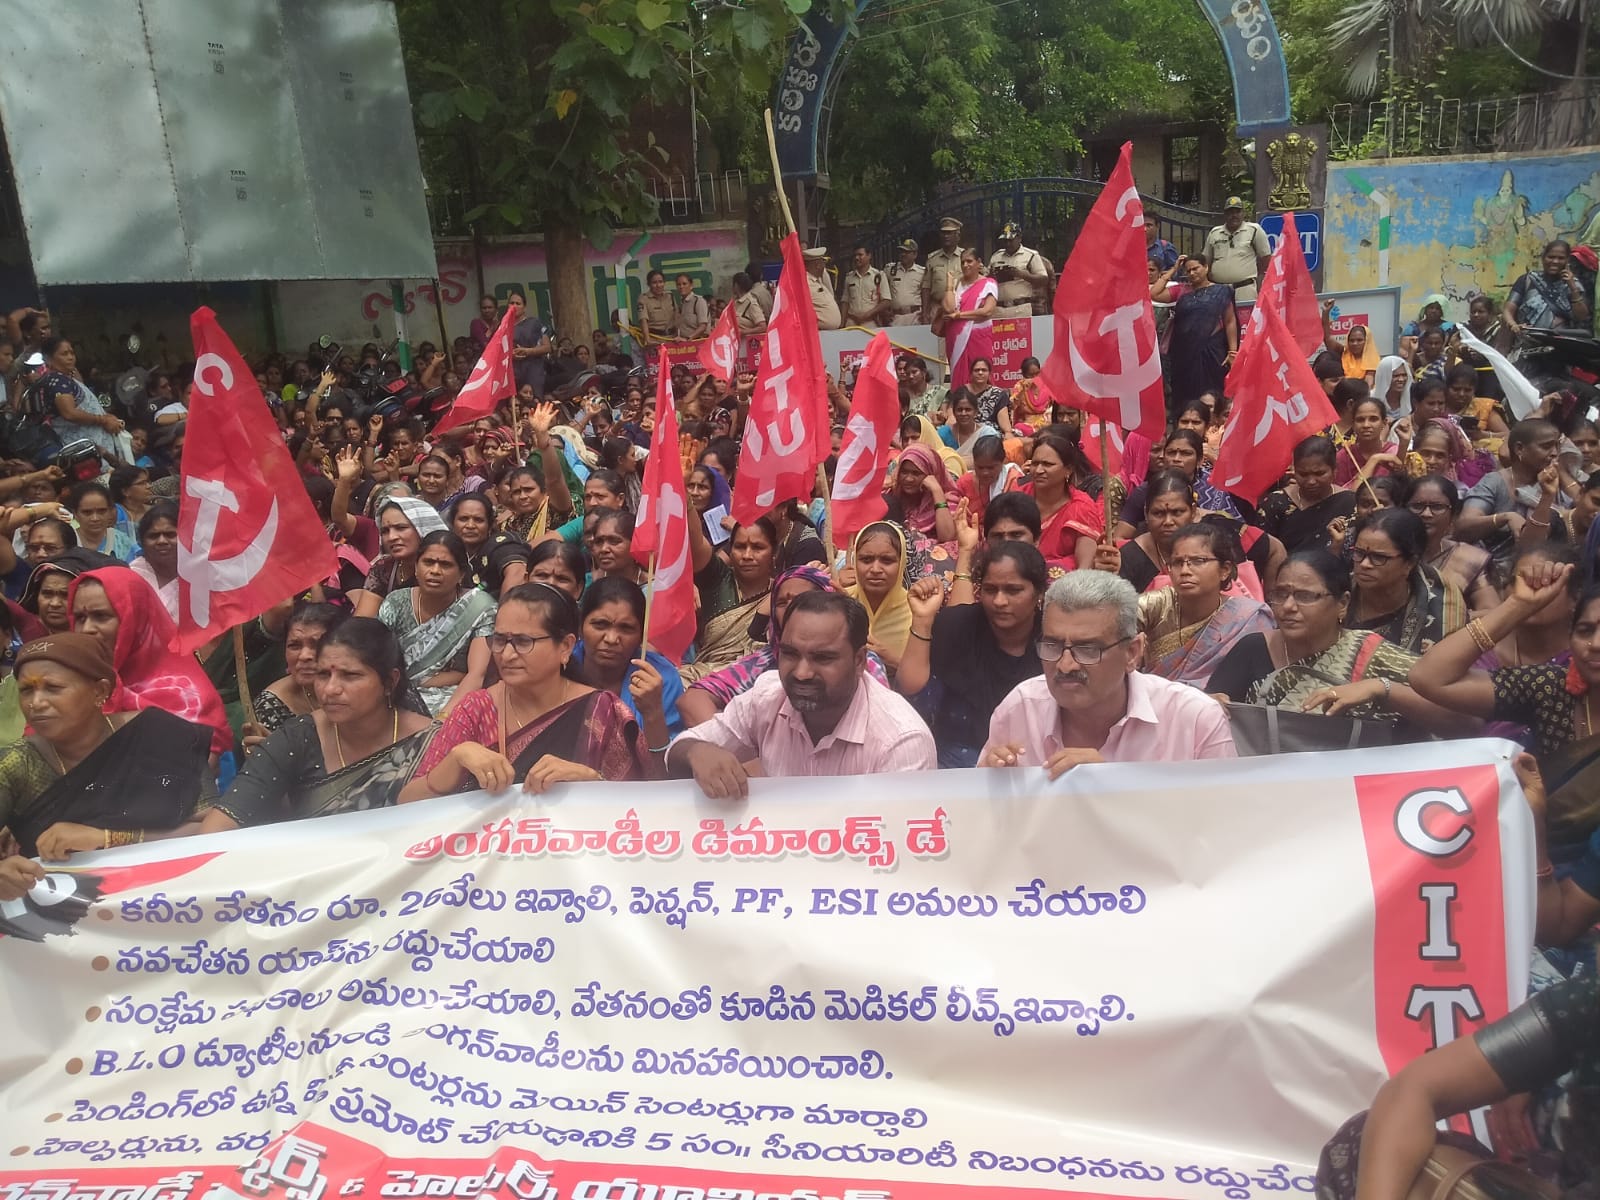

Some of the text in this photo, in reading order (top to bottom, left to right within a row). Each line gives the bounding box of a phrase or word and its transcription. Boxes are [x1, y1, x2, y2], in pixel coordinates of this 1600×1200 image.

[690, 814, 898, 868] డిమాండ్స్
[905, 805, 949, 856] డే
[120, 892, 204, 924] కనీస
[213, 889, 320, 928] వేతనం
[514, 884, 618, 924] ఇవ్వాలి,
[628, 880, 721, 930] పెన్షన్,
[730, 887, 793, 920] PF,
[808, 887, 879, 916] ESI
[886, 886, 999, 918] అమలు
[1007, 878, 1147, 918] చేయాలి
[115, 939, 251, 976] నవచేతన
[1392, 785, 1494, 1152] CIT
[104, 990, 217, 1035] సంక్షేమ
[570, 980, 712, 1021] వేతనంతో
[719, 984, 816, 1022] కూడిన
[823, 984, 938, 1022] మెడికల్
[630, 1047, 894, 1080] మినహాయించాలి.
[802, 1103, 929, 1139] మార్చాలి
[644, 1132, 674, 1152] 5
[761, 1133, 959, 1169] సీనియారిటీ
[967, 1150, 1166, 1182] నిబంధనను
